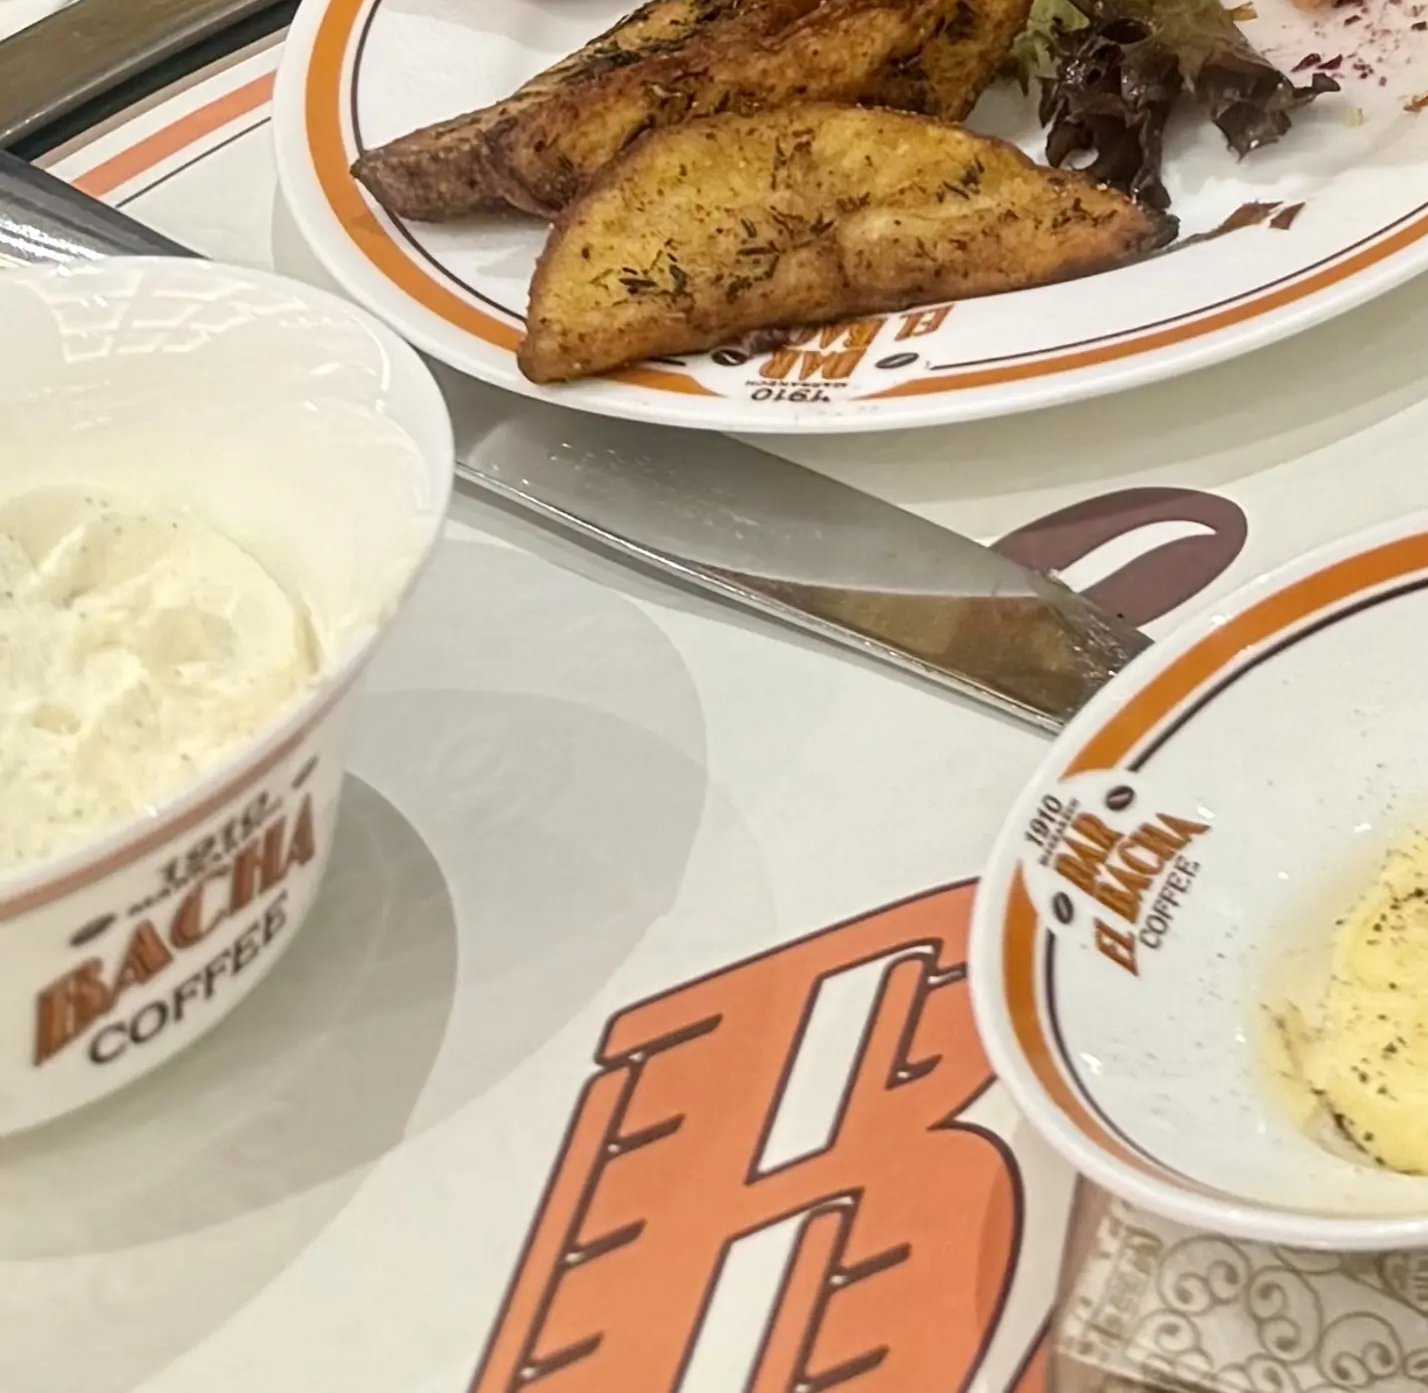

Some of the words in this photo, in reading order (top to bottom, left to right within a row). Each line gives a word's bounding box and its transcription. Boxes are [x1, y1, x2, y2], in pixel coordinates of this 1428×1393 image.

[893, 304, 955, 342] EL
[750, 388, 831, 403] 1910
[1024, 793, 1063, 848] 1910
[1095, 812, 1212, 924] BACHA
[32, 792, 316, 1067] BACHA
[1139, 853, 1201, 951] COFFEE
[87, 889, 289, 1065] COFFEE
